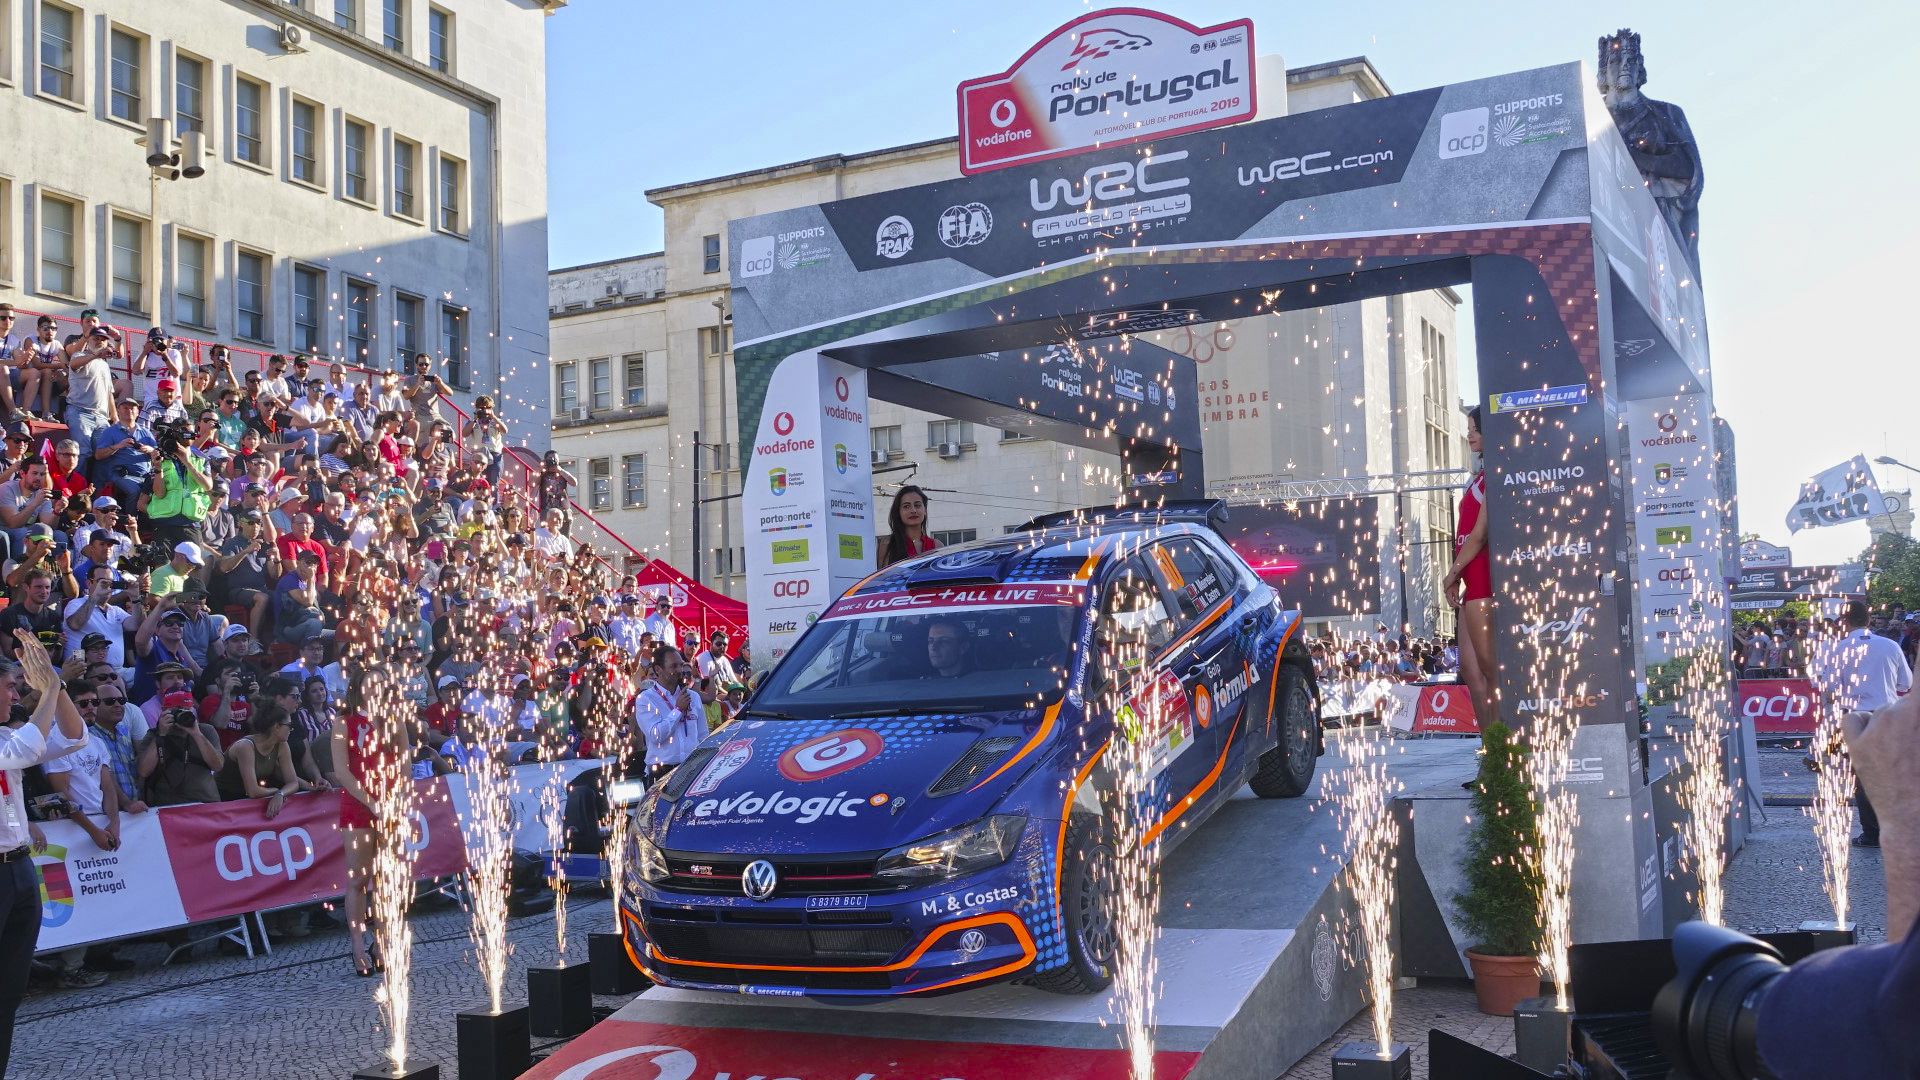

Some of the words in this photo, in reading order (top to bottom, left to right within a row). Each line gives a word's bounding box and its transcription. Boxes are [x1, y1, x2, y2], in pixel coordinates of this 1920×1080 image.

[1049, 59, 1239, 122] Portugal
[1050, 76, 1092, 94] rally
[1095, 70, 1117, 84] de
[1157, 115, 1166, 125] DE
[1168, 107, 1209, 121] PORTUGAL
[1210, 97, 1240, 112] 2019
[1494, 93, 1563, 116] SUPPORTS
[976, 128, 1032, 148] vodafone
[1448, 129, 1485, 152] acp
[1237, 150, 1394, 186] WRC.com
[1030, 150, 1190, 211] WRC
[942, 209, 988, 240] FIA
[1037, 222, 1060, 233] FIA
[1065, 211, 1123, 228] WORLD
[1128, 200, 1186, 217] RALLY
[778, 226, 825, 243] SUPPORTS
[1038, 217, 1187, 247] CHAMPIONSHIP
[876, 234, 914, 256] FPAK
[746, 257, 772, 272] acp
[1041, 372, 1083, 397] Portugal
[1059, 369, 1073, 381] rally
[1073, 372, 1081, 382] de
[1113, 364, 1143, 390] WRC
[1205, 390, 1270, 407] SIDADE
[1517, 390, 1579, 405] MICHELIN
[825, 405, 862, 423] vodafone
[757, 439, 815, 456] vodafone
[1641, 434, 1697, 447] vodafone
[1503, 465, 1584, 486] ANONIMO
[1524, 484, 1566, 496] watches
[197, 506, 207, 516] 07
[1658, 567, 1692, 582] acp
[773, 579, 810, 598] acp
[1205, 587, 1221, 604] Castro
[866, 593, 936, 610] WRC
[953, 589, 988, 602] ALL
[993, 588, 1038, 601] LIVE
[1754, 600, 1778, 608] FERME
[1653, 607, 1680, 616] Hertz
[769, 620, 797, 632] Hertz
[1082, 616, 1094, 646] Financial
[1075, 646, 1089, 688] Volkswagen
[1206, 662, 1222, 679] Galp
[1213, 659, 1261, 712] fórmula
[1742, 695, 1810, 722] acp
[694, 790, 866, 824] evologic
[697, 818, 727, 826] Intelligent
[741, 817, 765, 825] Agents
[74, 855, 119, 870] Turismo
[215, 826, 315, 882] acp
[77, 868, 114, 882] Centro
[80, 879, 127, 896] Portugal
[811, 896, 817, 906] S
[818, 896, 840, 906] 8379
[843, 895, 862, 906] BCC
[921, 900, 943, 917] M.
[947, 897, 961, 912] &
[964, 885, 1019, 907] Costas
[757, 988, 804, 997] MICHELIN
